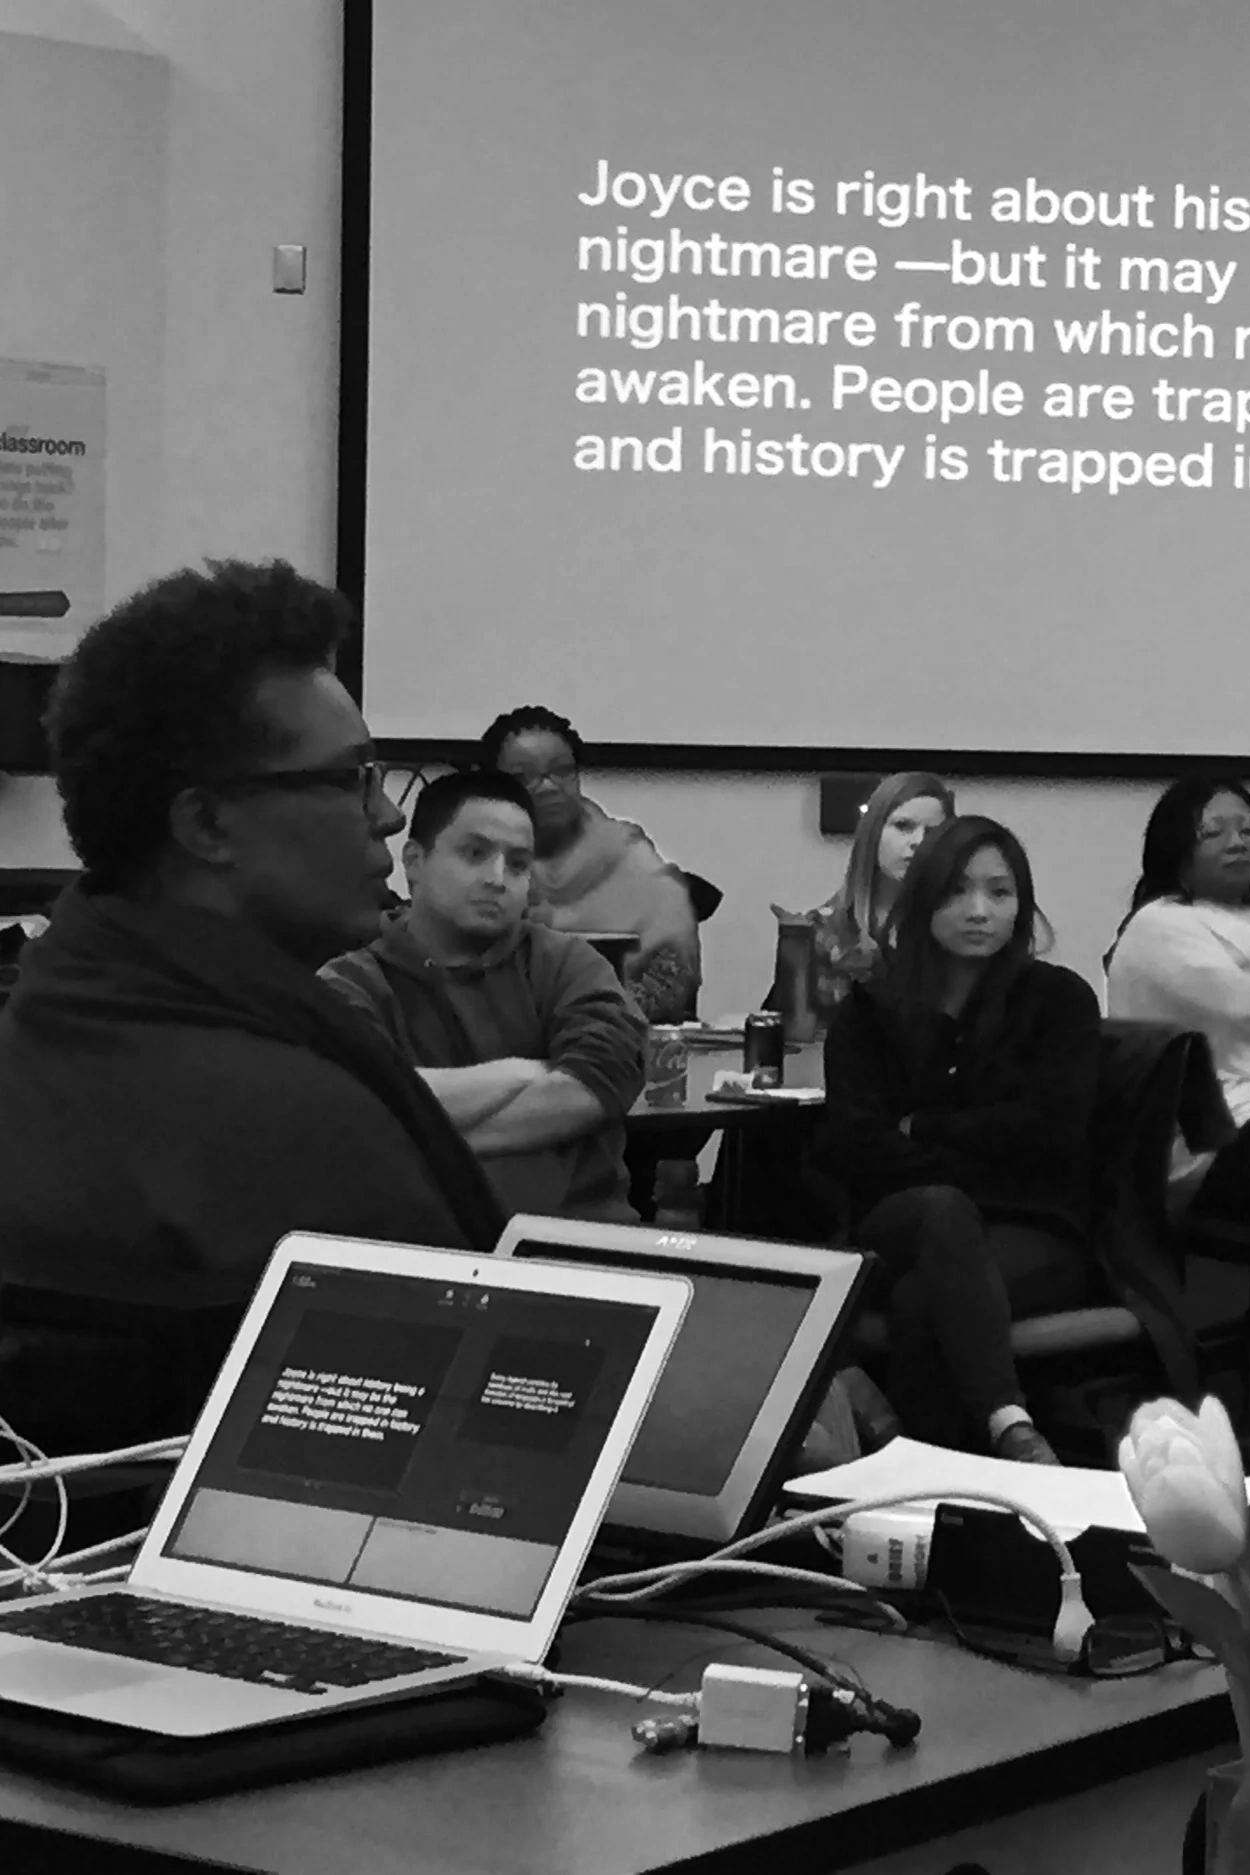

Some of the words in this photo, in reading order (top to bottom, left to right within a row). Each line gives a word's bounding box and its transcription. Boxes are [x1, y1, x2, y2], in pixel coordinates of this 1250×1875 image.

[577, 159, 751, 218] Joyce
[772, 166, 815, 214] is
[836, 170, 972, 228] right
[990, 177, 1155, 227] about
[578, 225, 878, 283] nightmare
[1065, 241, 1102, 290] it
[1120, 256, 1238, 305] may
[577, 291, 877, 350] nightmare
[893, 301, 1034, 353] from
[1053, 309, 1214, 359] which
[575, 359, 811, 410] awaken.
[832, 363, 1025, 425] People
[1043, 382, 1135, 420] are
[573, 426, 682, 473] and
[703, 427, 906, 489] history
[925, 433, 969, 481] is
[986, 439, 1214, 496] trapped
